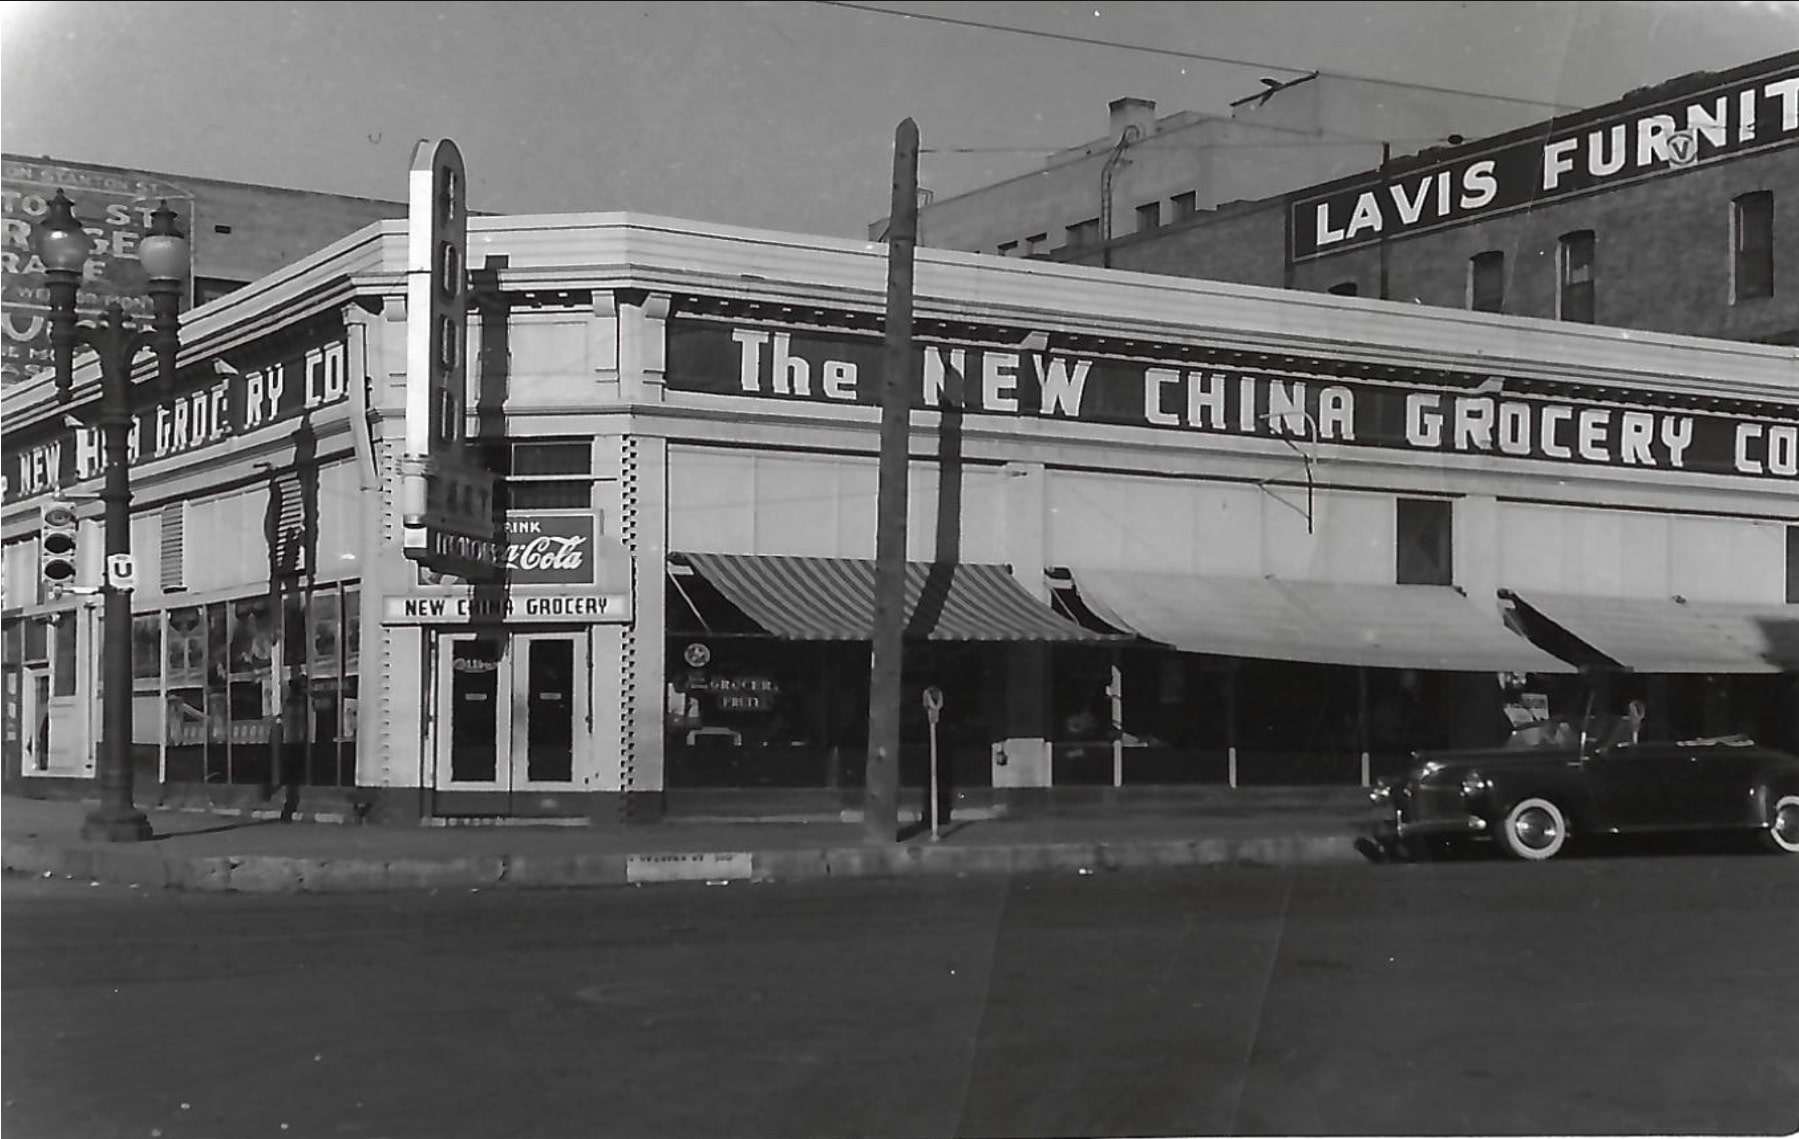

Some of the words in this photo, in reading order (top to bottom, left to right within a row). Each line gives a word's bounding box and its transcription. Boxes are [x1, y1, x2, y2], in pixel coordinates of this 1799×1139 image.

[1315, 159, 1498, 246] LAVIS
[1542, 77, 1799, 191] FURNIT
[19, 440, 61, 498] NEW
[304, 341, 346, 409] CO
[732, 328, 858, 400] The
[923, 346, 1093, 417] NEW
[1144, 367, 1356, 441] CHINA
[1405, 392, 1694, 468] GROCERY
[1735, 422, 1798, 476] CO
[405, 599, 446, 616] NEW
[526, 597, 609, 616] GROCERY
[500, 535, 588, 570] a-Cola
